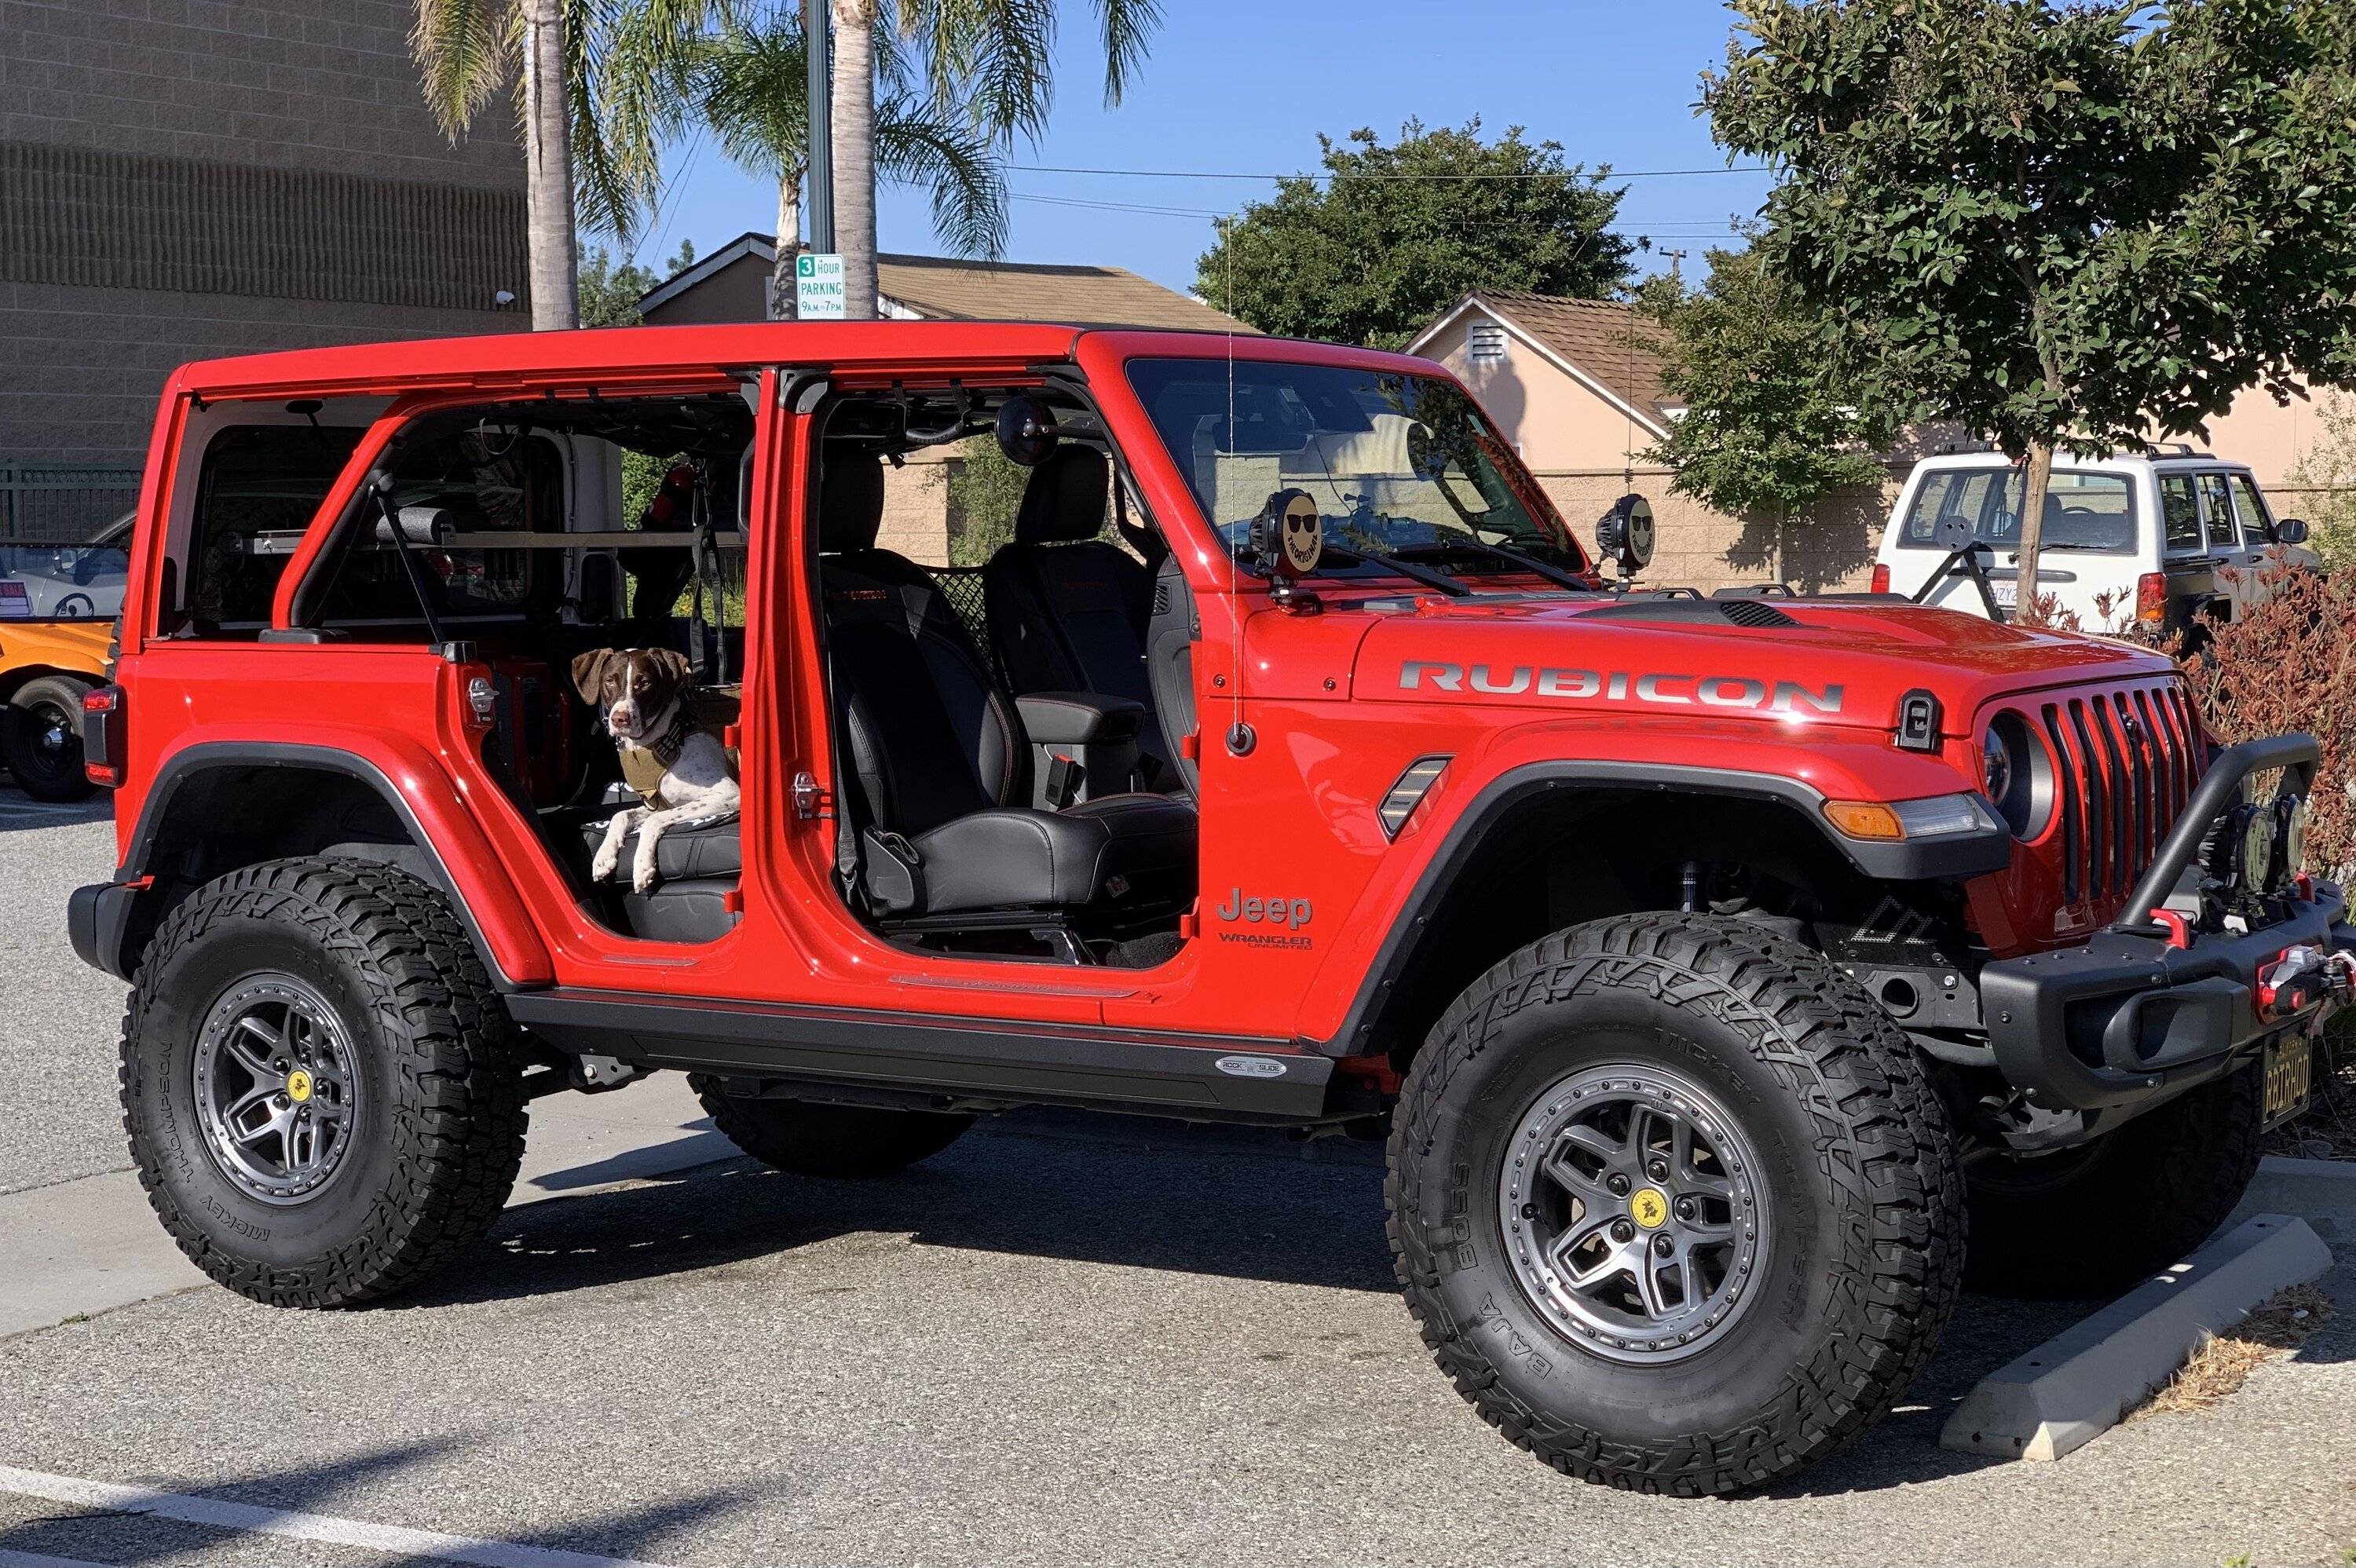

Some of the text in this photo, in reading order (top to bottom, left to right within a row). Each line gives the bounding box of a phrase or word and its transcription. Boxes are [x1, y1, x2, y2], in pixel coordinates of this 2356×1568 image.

[801, 258, 840, 275] 3 HOUR
[801, 283, 842, 295] PARKING
[1399, 660, 1844, 713] RUBICON
[1217, 887, 1312, 930] Jeep
[1218, 932, 1312, 946] WRANGLER
[1248, 942, 1313, 951] UNLIMITED
[158, 1040, 195, 1183] THOMPSON
[200, 1193, 271, 1242] MICKEY
[1453, 1162, 1478, 1270] BOSS
[1478, 1291, 1553, 1380] BAJA
